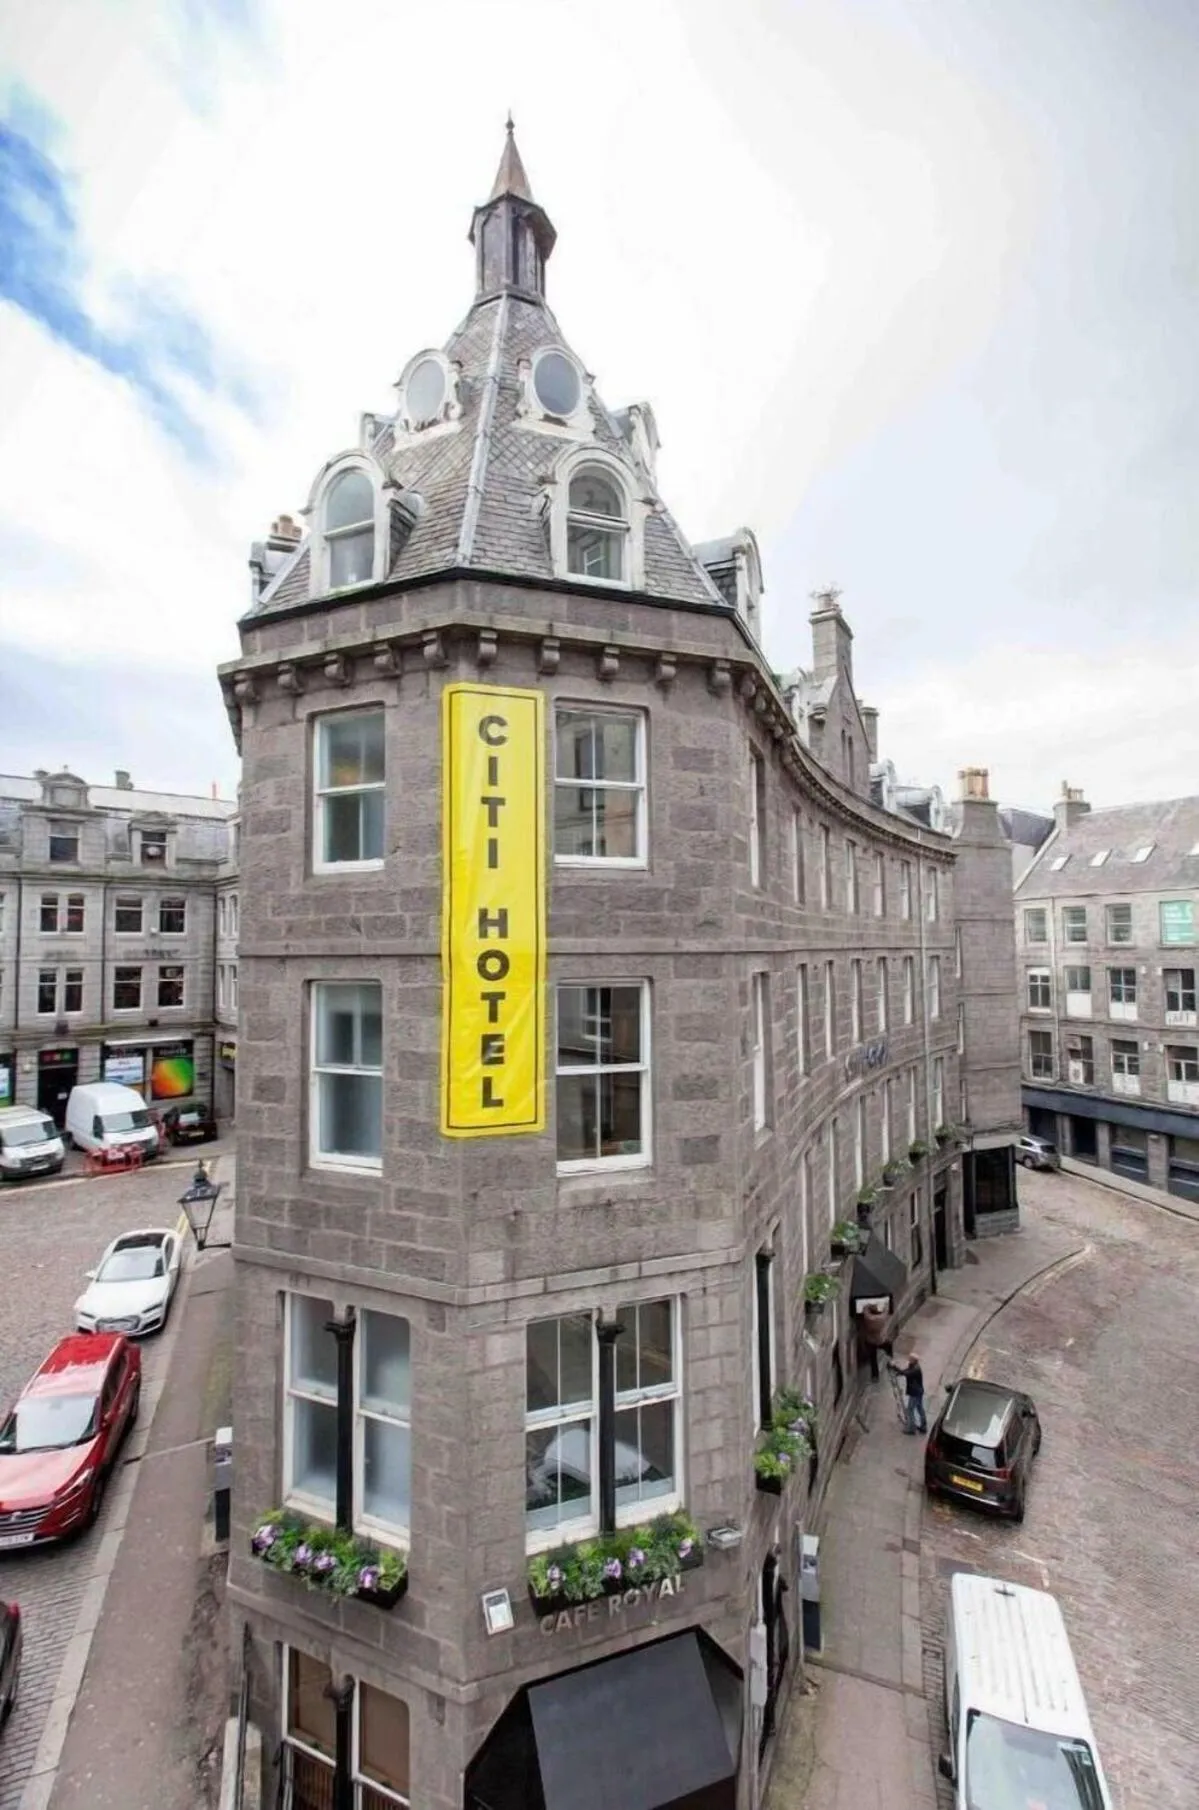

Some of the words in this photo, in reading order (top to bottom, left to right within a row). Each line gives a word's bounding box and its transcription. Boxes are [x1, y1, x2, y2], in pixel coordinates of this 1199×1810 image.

[479, 715, 508, 869] CITI
[477, 907, 511, 1109] HOTEL
[607, 1574, 685, 1617] ROYAL
